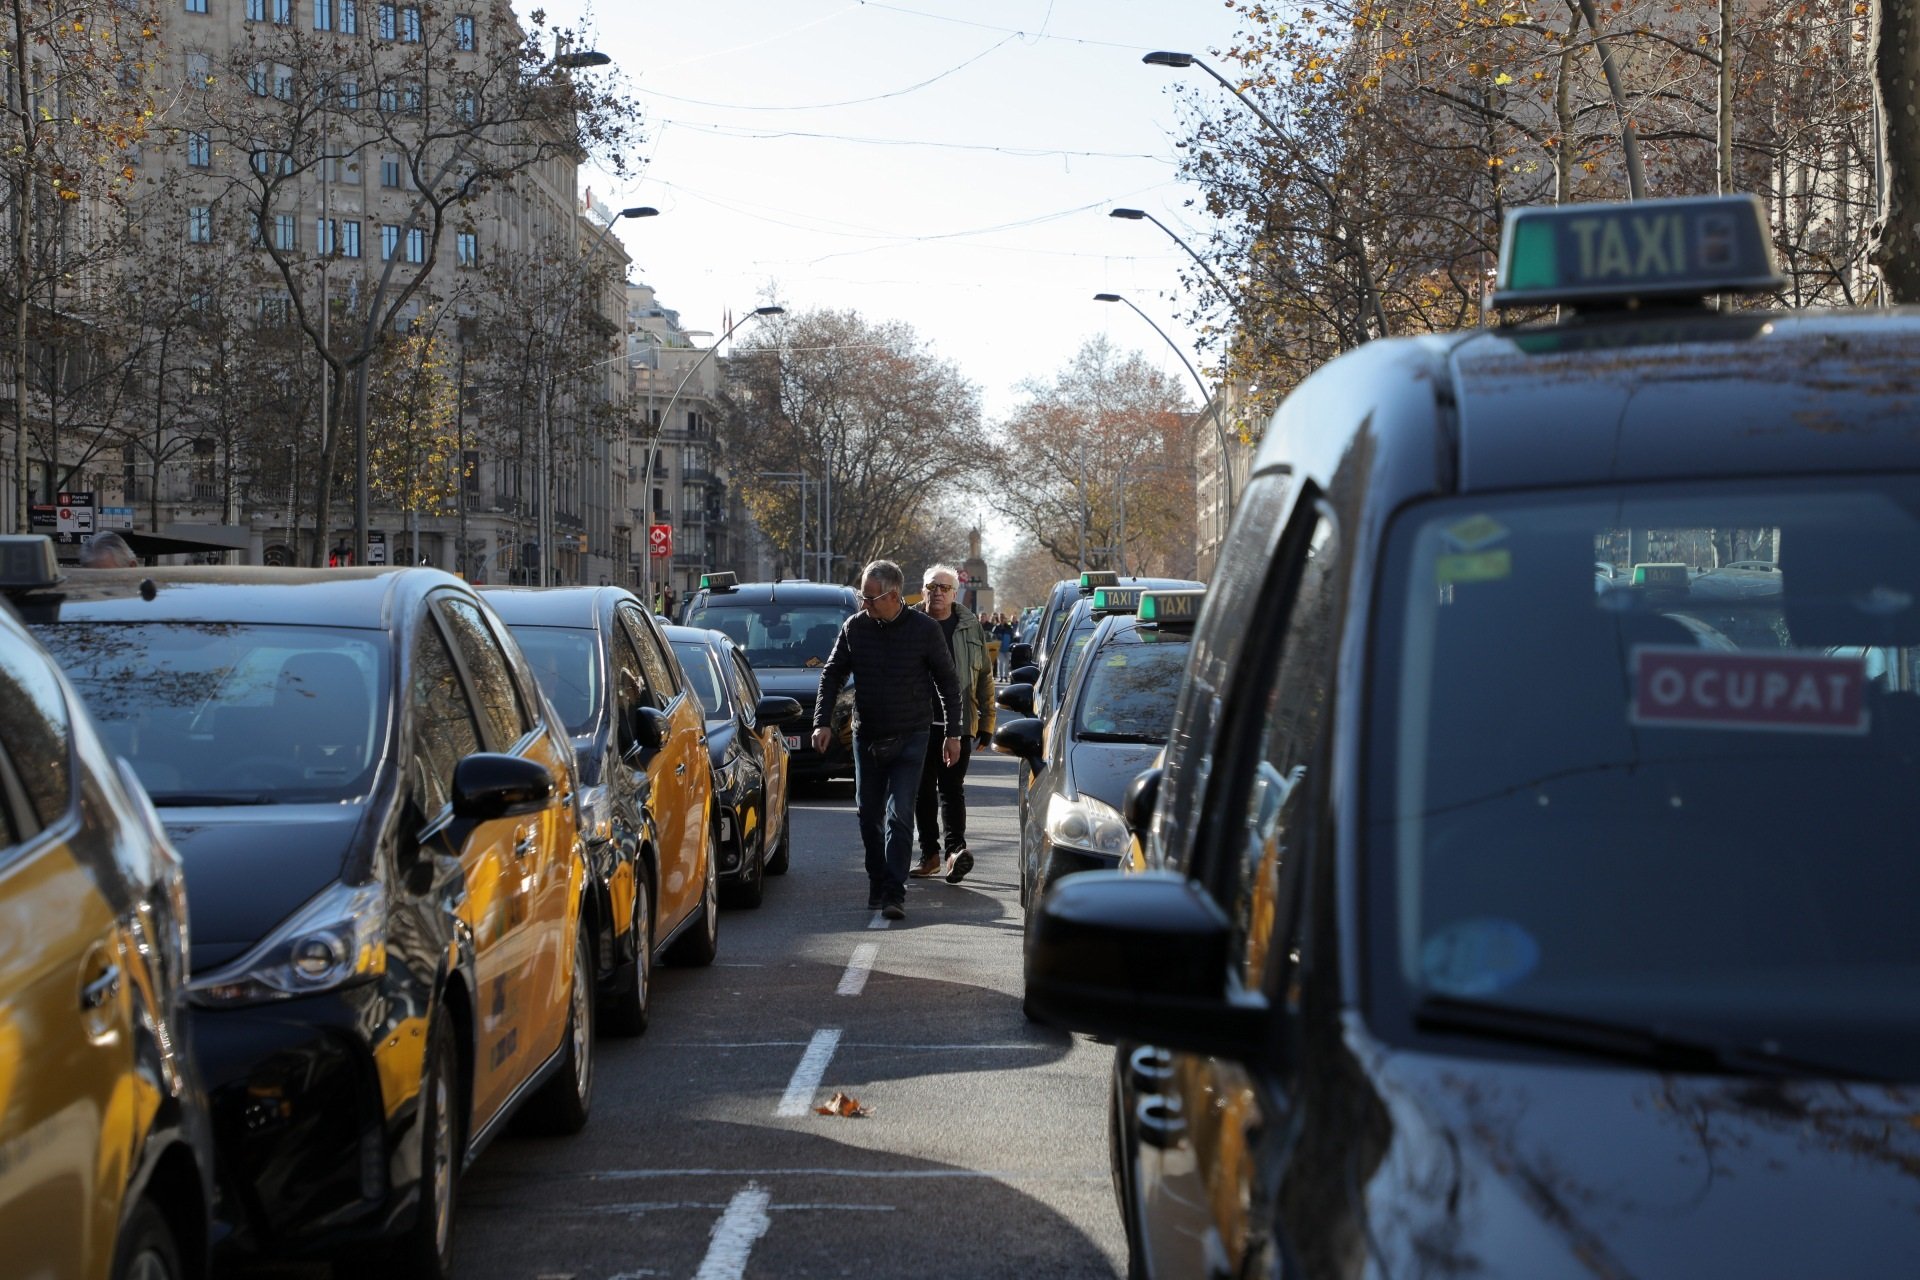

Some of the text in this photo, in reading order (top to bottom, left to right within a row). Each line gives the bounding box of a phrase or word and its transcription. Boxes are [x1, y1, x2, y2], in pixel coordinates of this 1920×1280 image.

[1570, 214, 1687, 279] TAXI
[711, 575, 725, 584] TAXI
[1090, 575, 1106, 585] TAXI
[1107, 592, 1131, 606] TAXI
[1158, 597, 1191, 615] TAXI
[1650, 667, 1848, 713] OCUPAT
